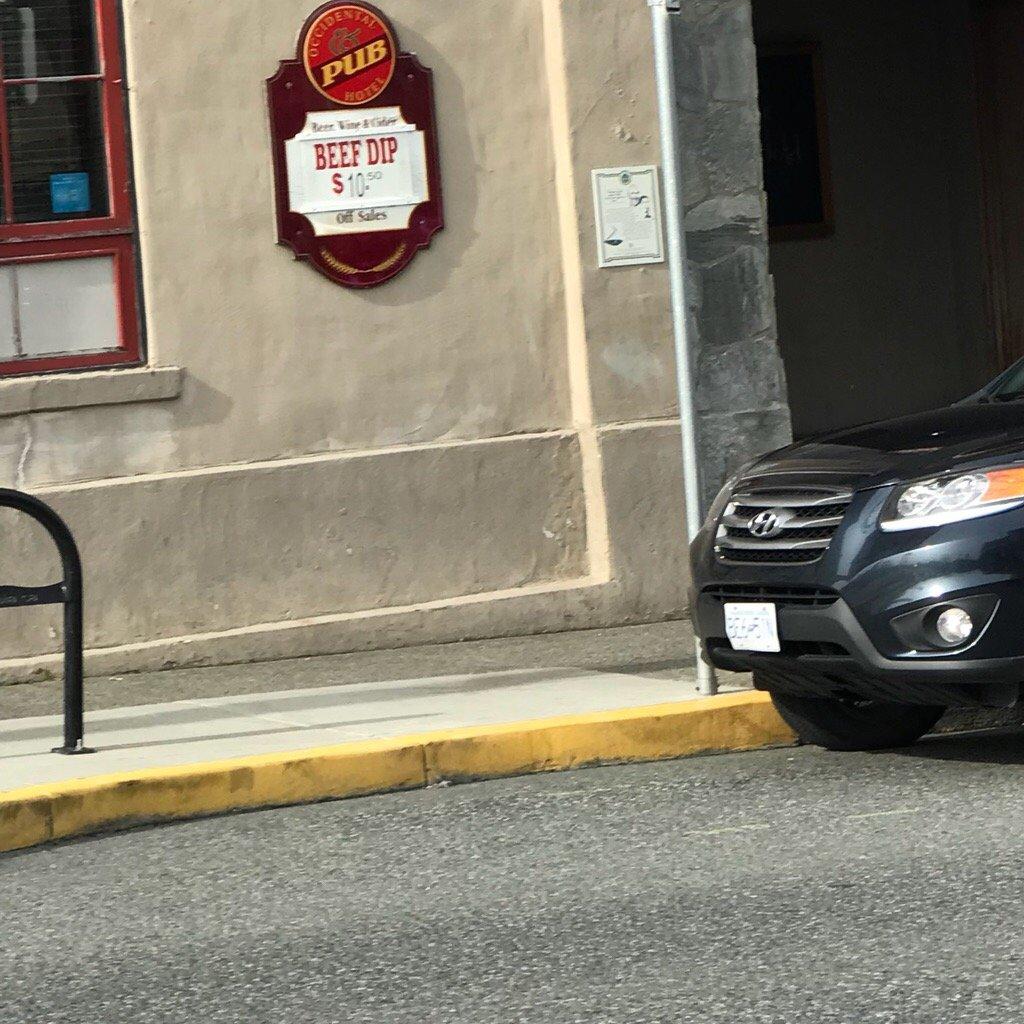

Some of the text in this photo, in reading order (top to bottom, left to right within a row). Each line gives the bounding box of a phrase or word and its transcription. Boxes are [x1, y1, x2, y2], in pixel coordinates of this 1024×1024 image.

[309, 9, 377, 57] OCCIDENTAL
[320, 39, 387, 87] PUB
[344, 77, 384, 101] HOTEL
[314, 137, 397, 170] BEEF DIP
